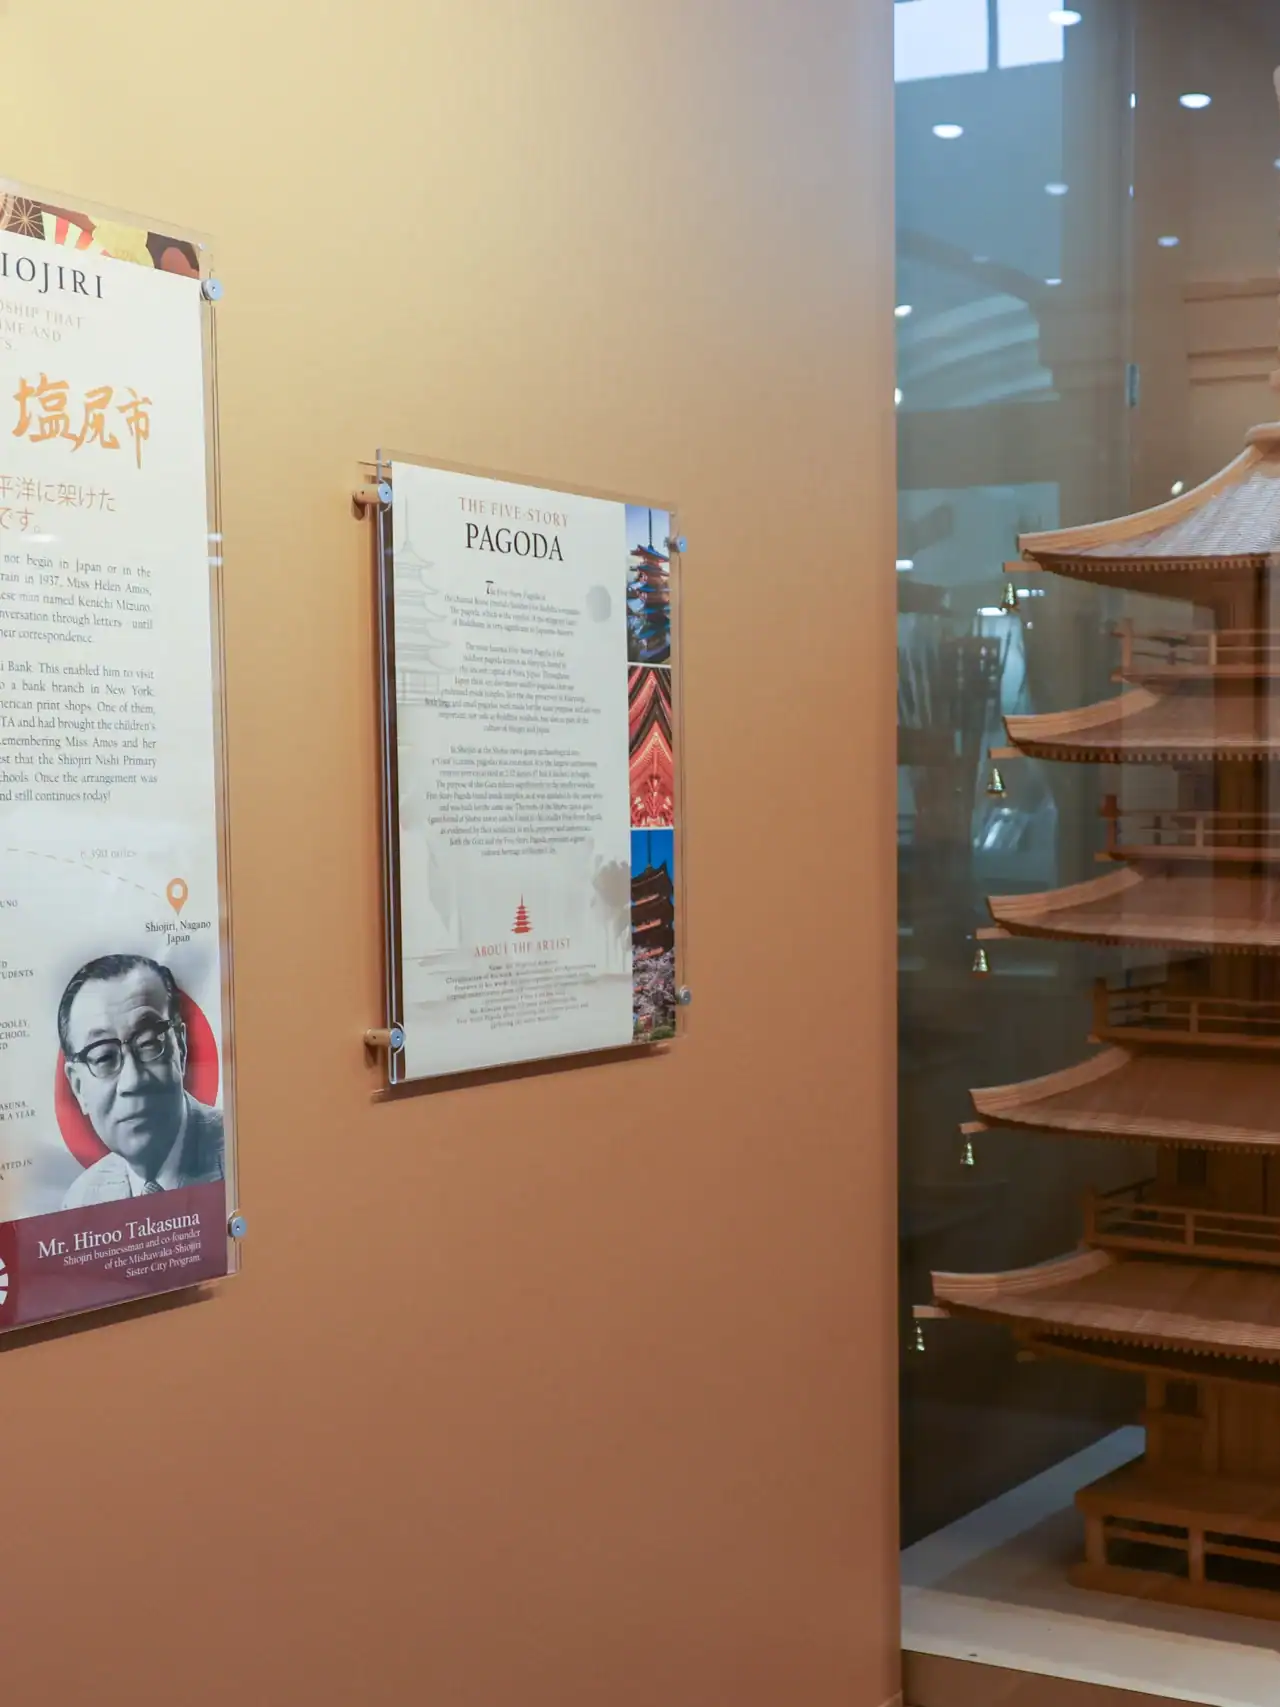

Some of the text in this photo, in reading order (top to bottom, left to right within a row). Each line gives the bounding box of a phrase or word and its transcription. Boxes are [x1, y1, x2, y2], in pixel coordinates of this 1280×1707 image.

[1, 252, 103, 299] IOJIRI
[46, 309, 86, 330] THAT
[31, 326, 62, 342] AND
[12, 372, 153, 470] 塩尻市
[458, 496, 485, 514] THE
[465, 522, 564, 562] PAGODA
[4, 554, 20, 565] not
[26, 553, 53, 569] begin
[59, 557, 69, 569] in
[76, 557, 102, 574] Japan
[137, 565, 152, 578] the
[25, 574, 34, 584] in
[67, 576, 90, 589] Miss
[94, 579, 121, 592] Helen
[19, 593, 39, 602] man
[43, 593, 74, 606] named
[52, 611, 90, 628] through
[132, 618, 154, 630] until
[37, 661, 59, 674] This
[63, 662, 99, 677] enabled
[103, 664, 120, 677] him
[123, 667, 133, 679] to
[22, 679, 46, 692] bank
[51, 680, 85, 694] branch
[90, 683, 100, 694] in
[105, 683, 126, 696] New
[36, 700, 61, 713] print
[97, 701, 116, 713] One
[119, 701, 129, 713] of
[18, 716, 35, 728] and
[38, 716, 55, 729] had
[58, 717, 95, 732] brought
[97, 718, 112, 731] the
[0, 735, 157, 750] emembering Miss Amos and her
[14, 752, 33, 765] that
[38, 752, 54, 765] the
[96, 754, 119, 766] Nishi
[123, 755, 158, 769] Primary
[34, 771, 59, 783] Once
[62, 771, 78, 783] the
[81, 773, 137, 785] arrangement
[140, 774, 158, 784] was
[14, 789, 33, 801] still
[35, 790, 81, 802] continues
[179, 919, 211, 931] Nagano
[166, 933, 190, 946] Japan
[38, 1212, 200, 1259] Mr. Hiroo Takasuna
[63, 1252, 93, 1267] Shiojiri
[94, 1240, 144, 1260] businessman
[145, 1236, 160, 1249] and
[104, 1259, 113, 1271] of
[114, 1256, 128, 1268] the
[126, 1265, 149, 1278] Sister
[150, 1261, 167, 1274] City
